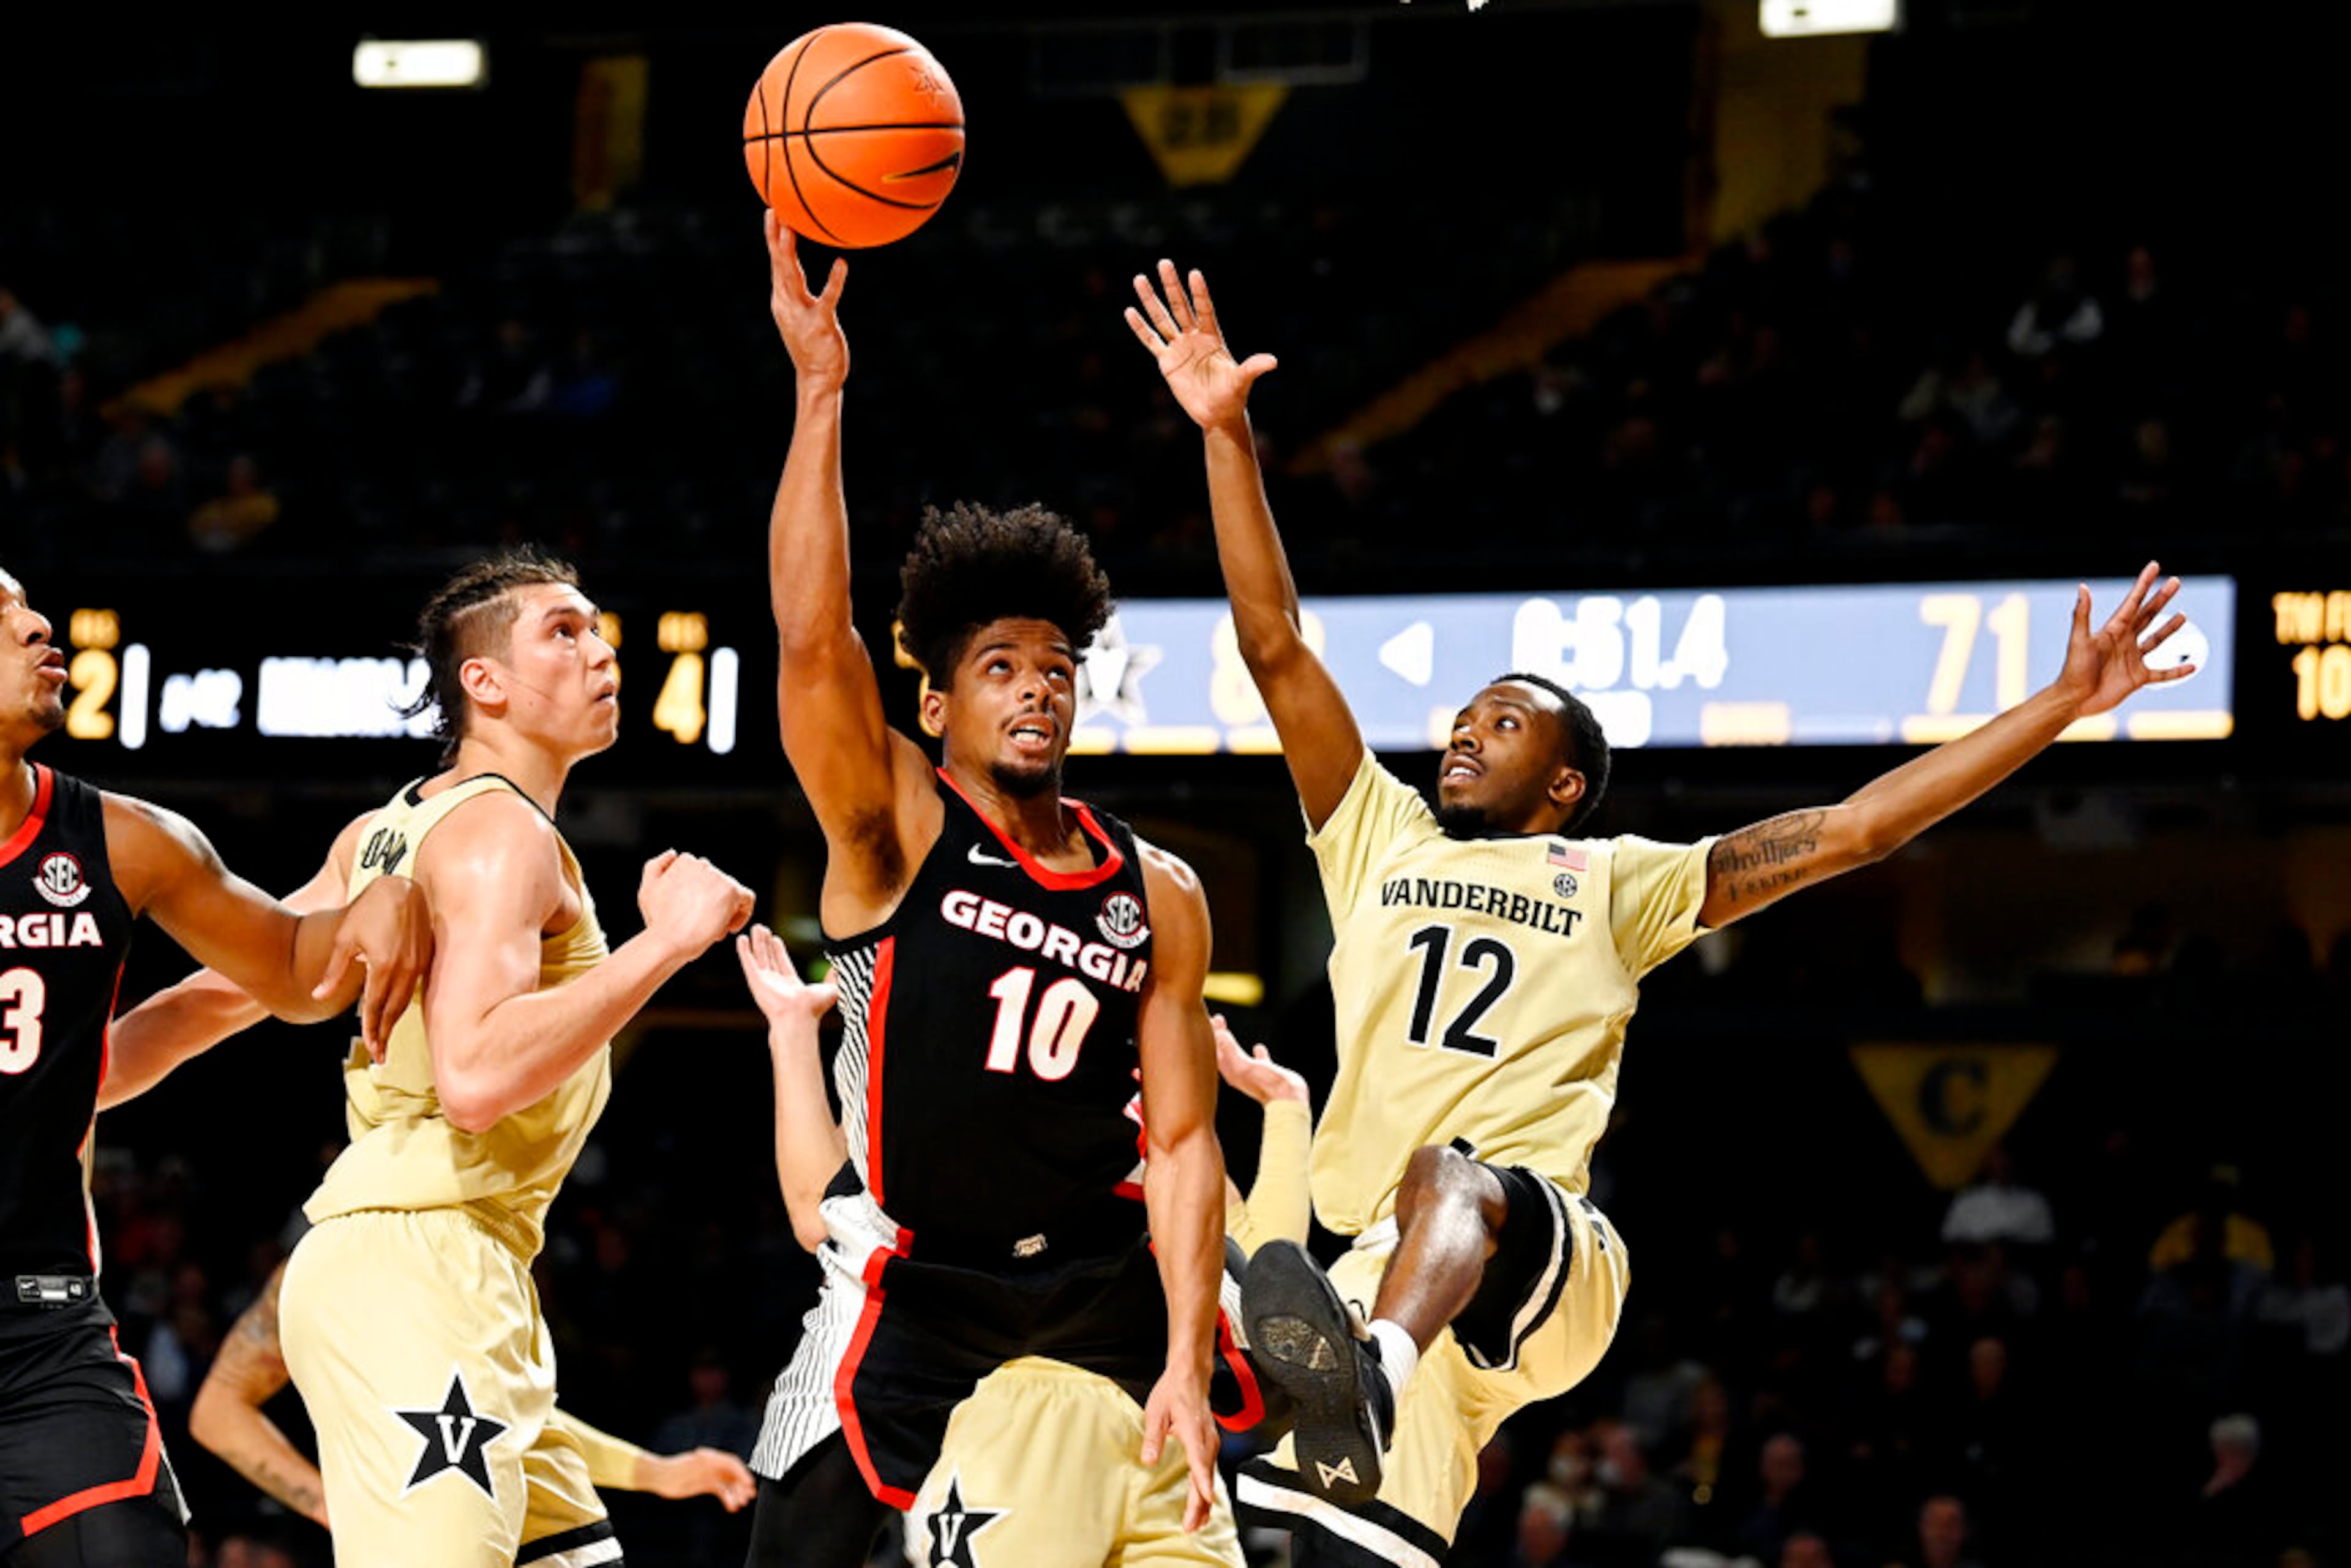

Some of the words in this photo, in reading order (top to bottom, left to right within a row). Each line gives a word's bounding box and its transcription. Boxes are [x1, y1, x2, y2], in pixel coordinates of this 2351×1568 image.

[653, 651, 707, 744] 4
[1920, 594, 2029, 715] 71
[42, 855, 80, 894] SEC
[1104, 893, 1141, 935] SEC
[1381, 878, 1582, 937] VANDERBILT
[940, 890, 1148, 992] GEORGIA
[0, 965, 47, 1075] 3
[984, 965, 1100, 1082] 10
[1407, 925, 1515, 1058] 12
[1919, 1057, 1989, 1138] C
[435, 1414, 476, 1465] V
[938, 1513, 966, 1558] V
